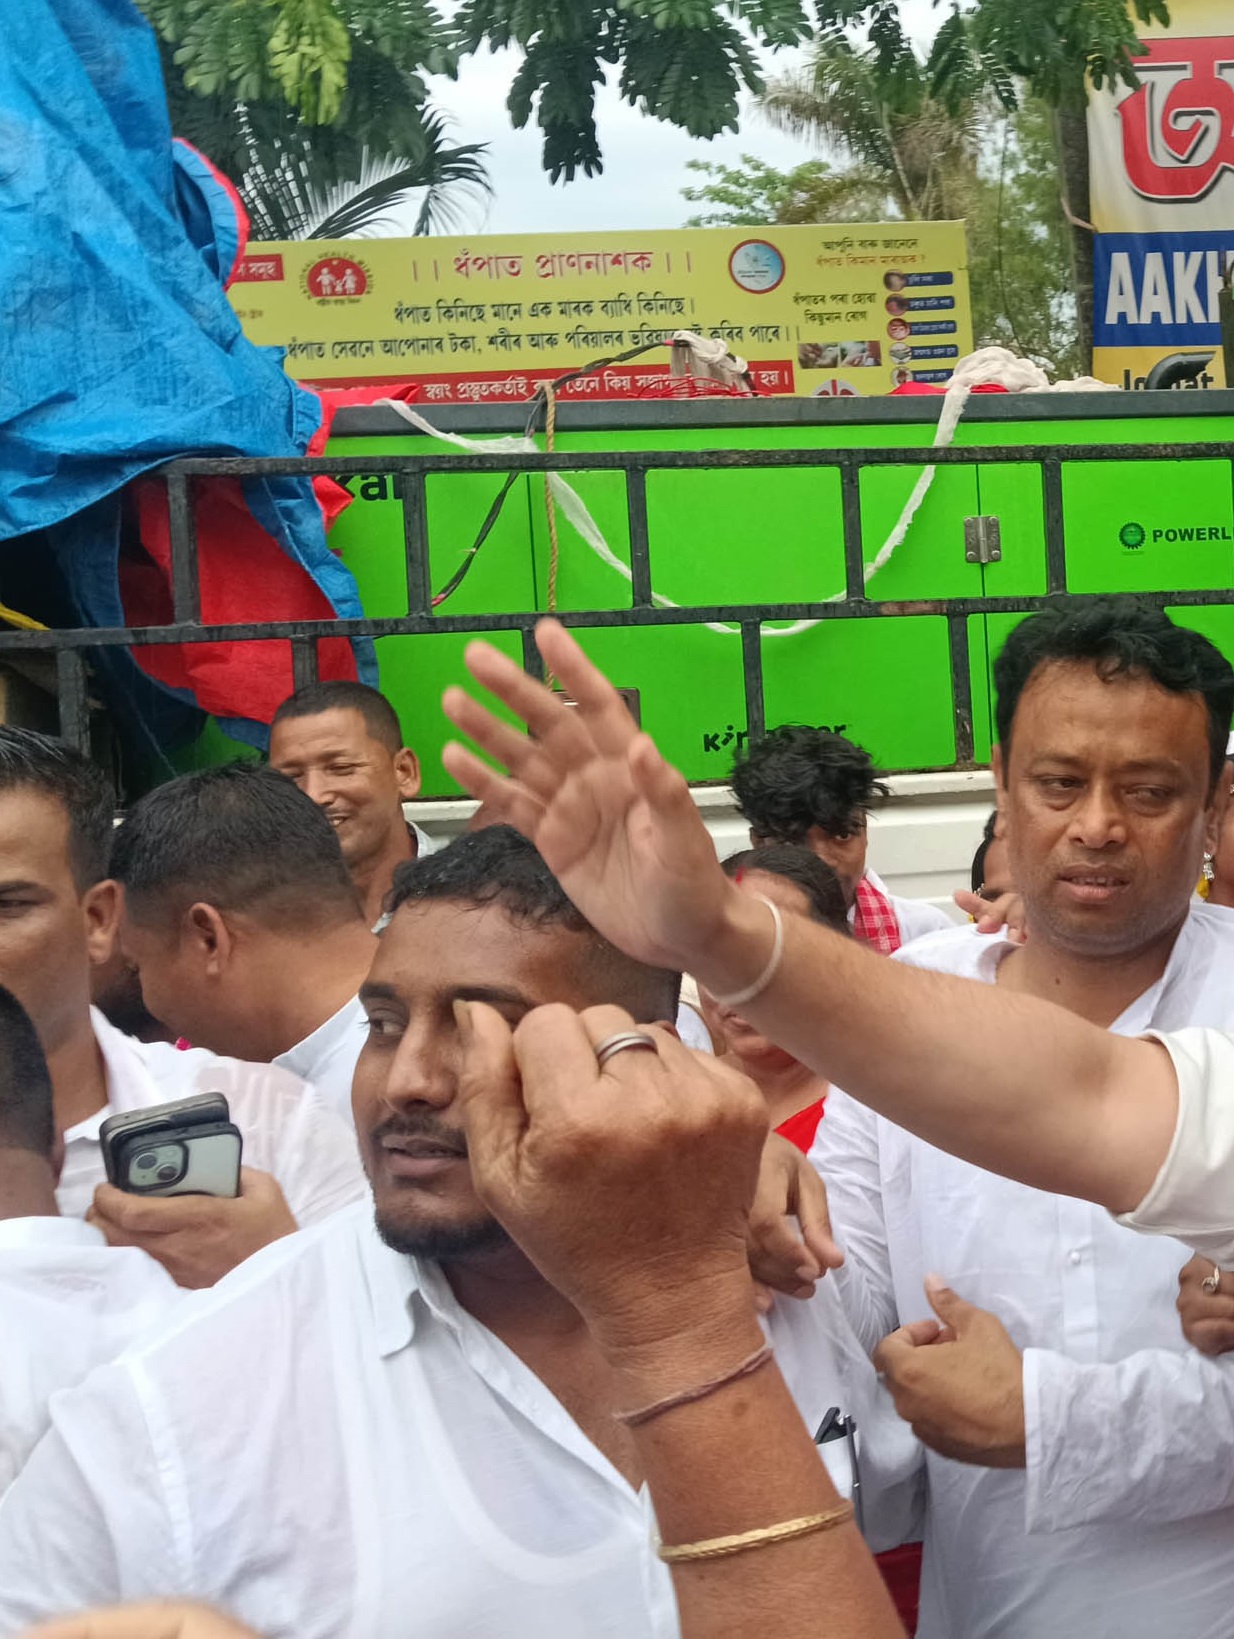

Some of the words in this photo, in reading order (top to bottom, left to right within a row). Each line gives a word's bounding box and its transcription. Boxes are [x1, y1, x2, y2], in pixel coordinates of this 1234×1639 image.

[535, 251, 654, 279] প্ৰাণনাশক
[436, 297, 486, 324] কিনিছে
[491, 303, 523, 322] মানে
[529, 302, 553, 319] এক
[637, 290, 686, 316] কিনিছে
